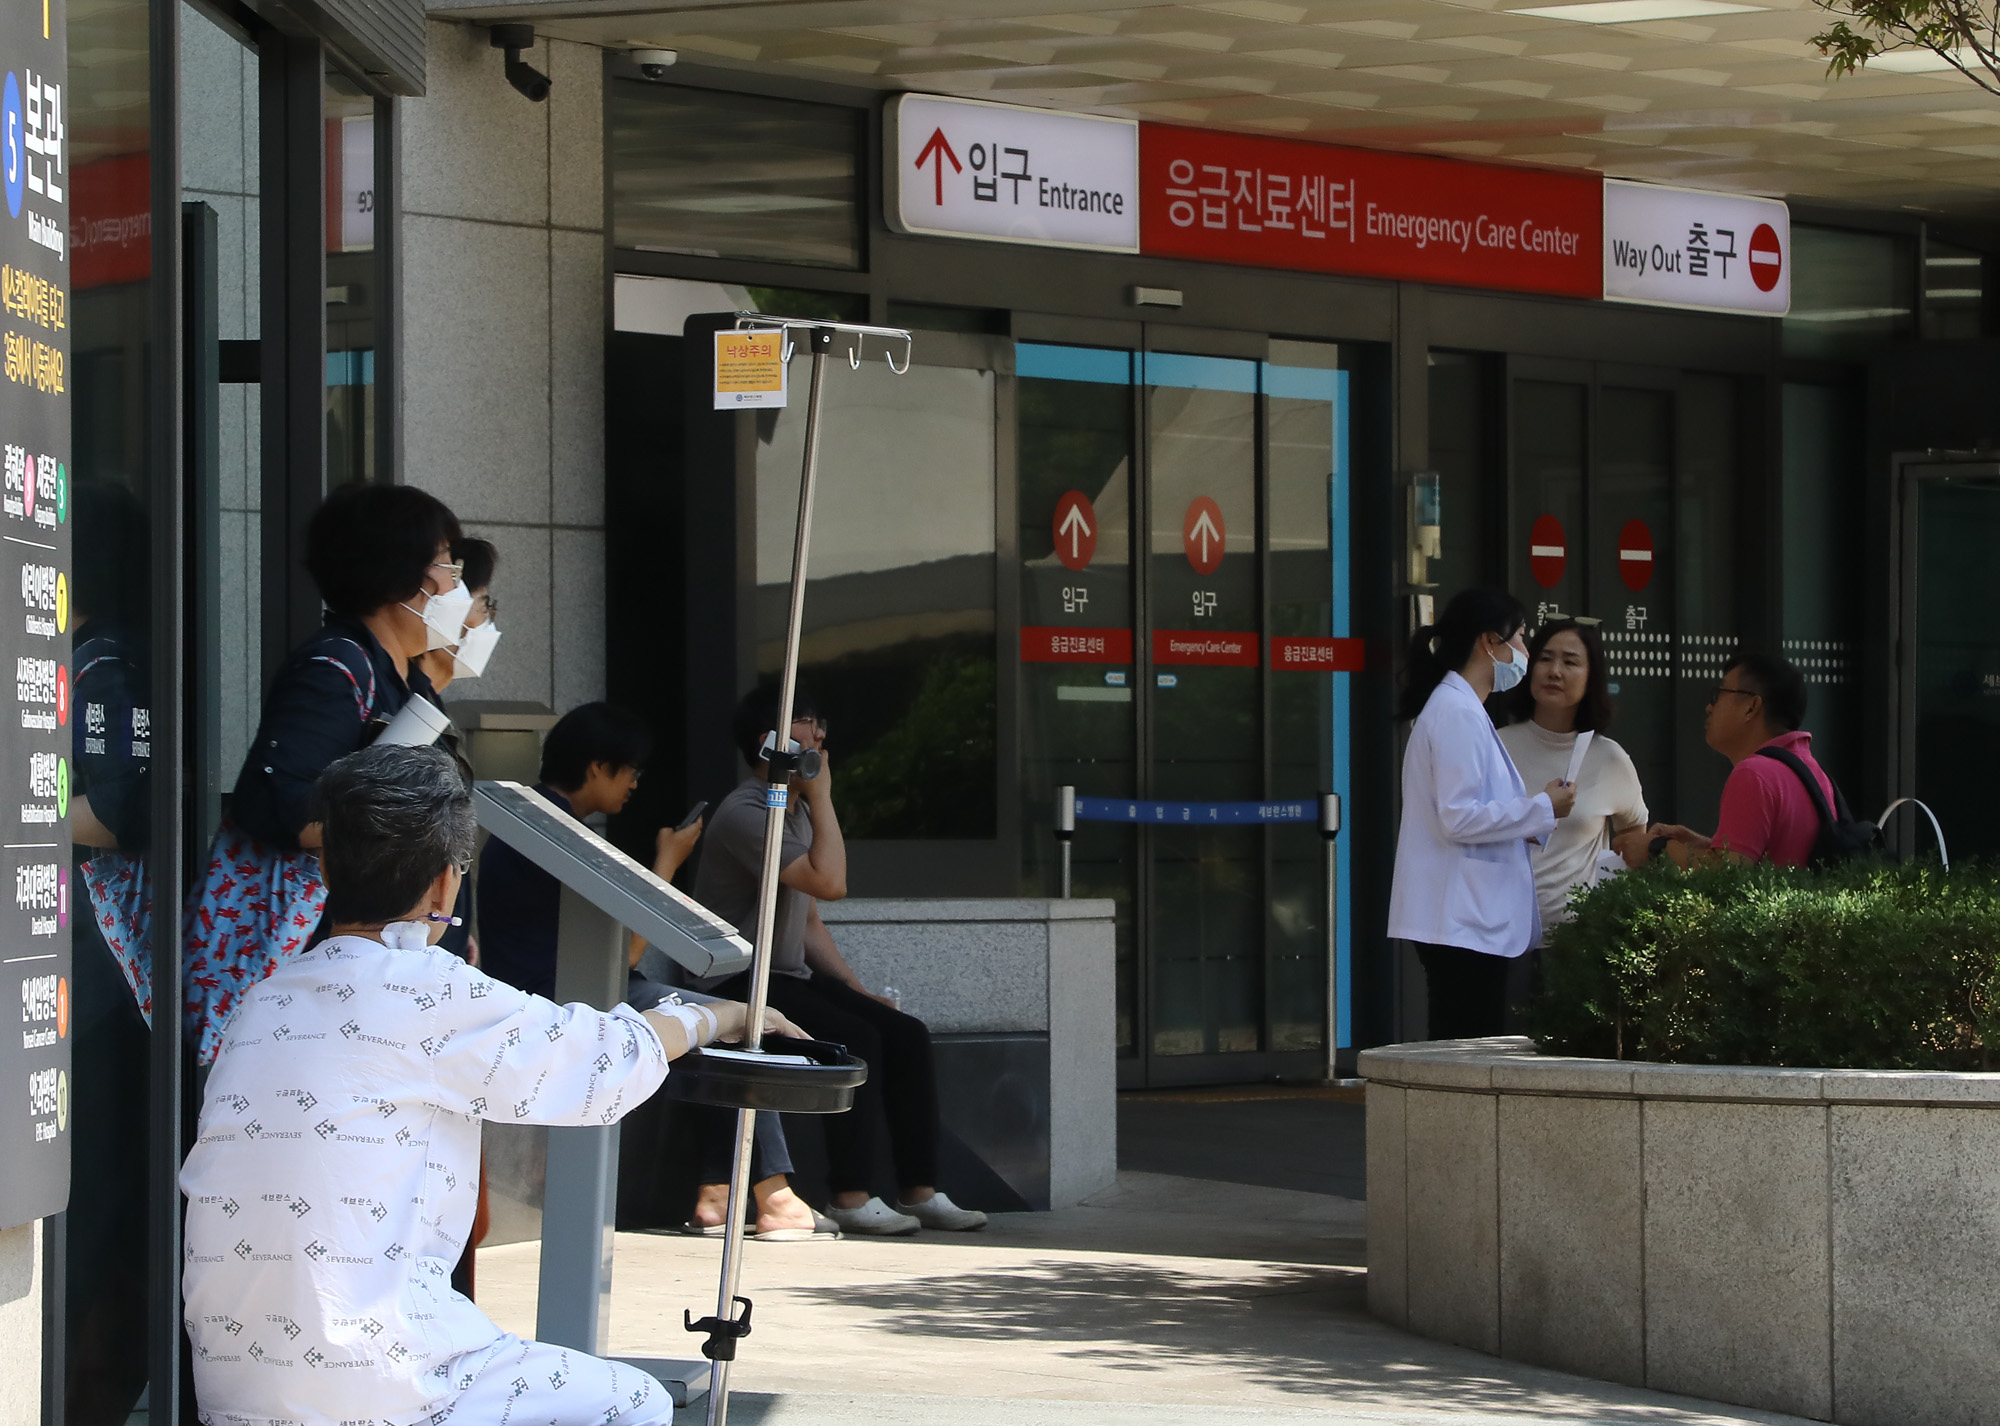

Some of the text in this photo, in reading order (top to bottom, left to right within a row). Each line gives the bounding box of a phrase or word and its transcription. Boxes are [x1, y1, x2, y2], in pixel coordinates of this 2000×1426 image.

[8, 69, 64, 203] 5 본관
[968, 142, 1124, 215] 입구 Entrance
[1166, 159, 1579, 255] 응급진료센터 Emergency Care Center
[1613, 222, 1737, 279] Way Out 출구
[50, 283, 66, 333] 타고
[4, 330, 32, 388] 3층에서
[726, 344, 772, 358] 낙상주의
[58, 479, 64, 511] 3
[21, 562, 56, 611] 어린이병원
[1062, 586, 1089, 613] 입구
[1192, 591, 1217, 616] 입구
[1626, 605, 1647, 629] 출구
[1051, 636, 1104, 654] 응급진료센터
[1169, 639, 1242, 656] Emergency Care Center
[1284, 646, 1333, 663] 응급진료센터
[16, 656, 65, 712] 심장혈관병원 8
[30, 752, 57, 798] 재활병원
[16, 863, 66, 915] 치과대학병원 11
[315, 983, 340, 993] 세브란스
[382, 982, 417, 996] 세브란스
[22, 974, 64, 1025] 연세암병원 1
[286, 1033, 327, 1042] SEVERANCE
[356, 1033, 407, 1051] SEVERANCE
[432, 1028, 457, 1056] 세브란스
[483, 1041, 506, 1087] SEVERANCE
[29, 1067, 58, 1117] 안과병원
[275, 1089, 304, 1098] 세브란스
[582, 1072, 598, 1118] SEVERANCE
[199, 1134, 236, 1144] SEVERANCE
[260, 1132, 302, 1140] SEVERANCE
[336, 1134, 385, 1145] SEVERANCE
[198, 1196, 224, 1204] 세브란스
[261, 1194, 291, 1202] 세브란스
[339, 1196, 373, 1206] 세브란스
[252, 1254, 292, 1262] SEVERANCE
[325, 1256, 374, 1265] SEVERANCE
[204, 1315, 230, 1324] 세브란스
[265, 1314, 288, 1324] 세브란스
[332, 1318, 366, 1326] 세브란스
[324, 1360, 374, 1368] SEVERANCE
